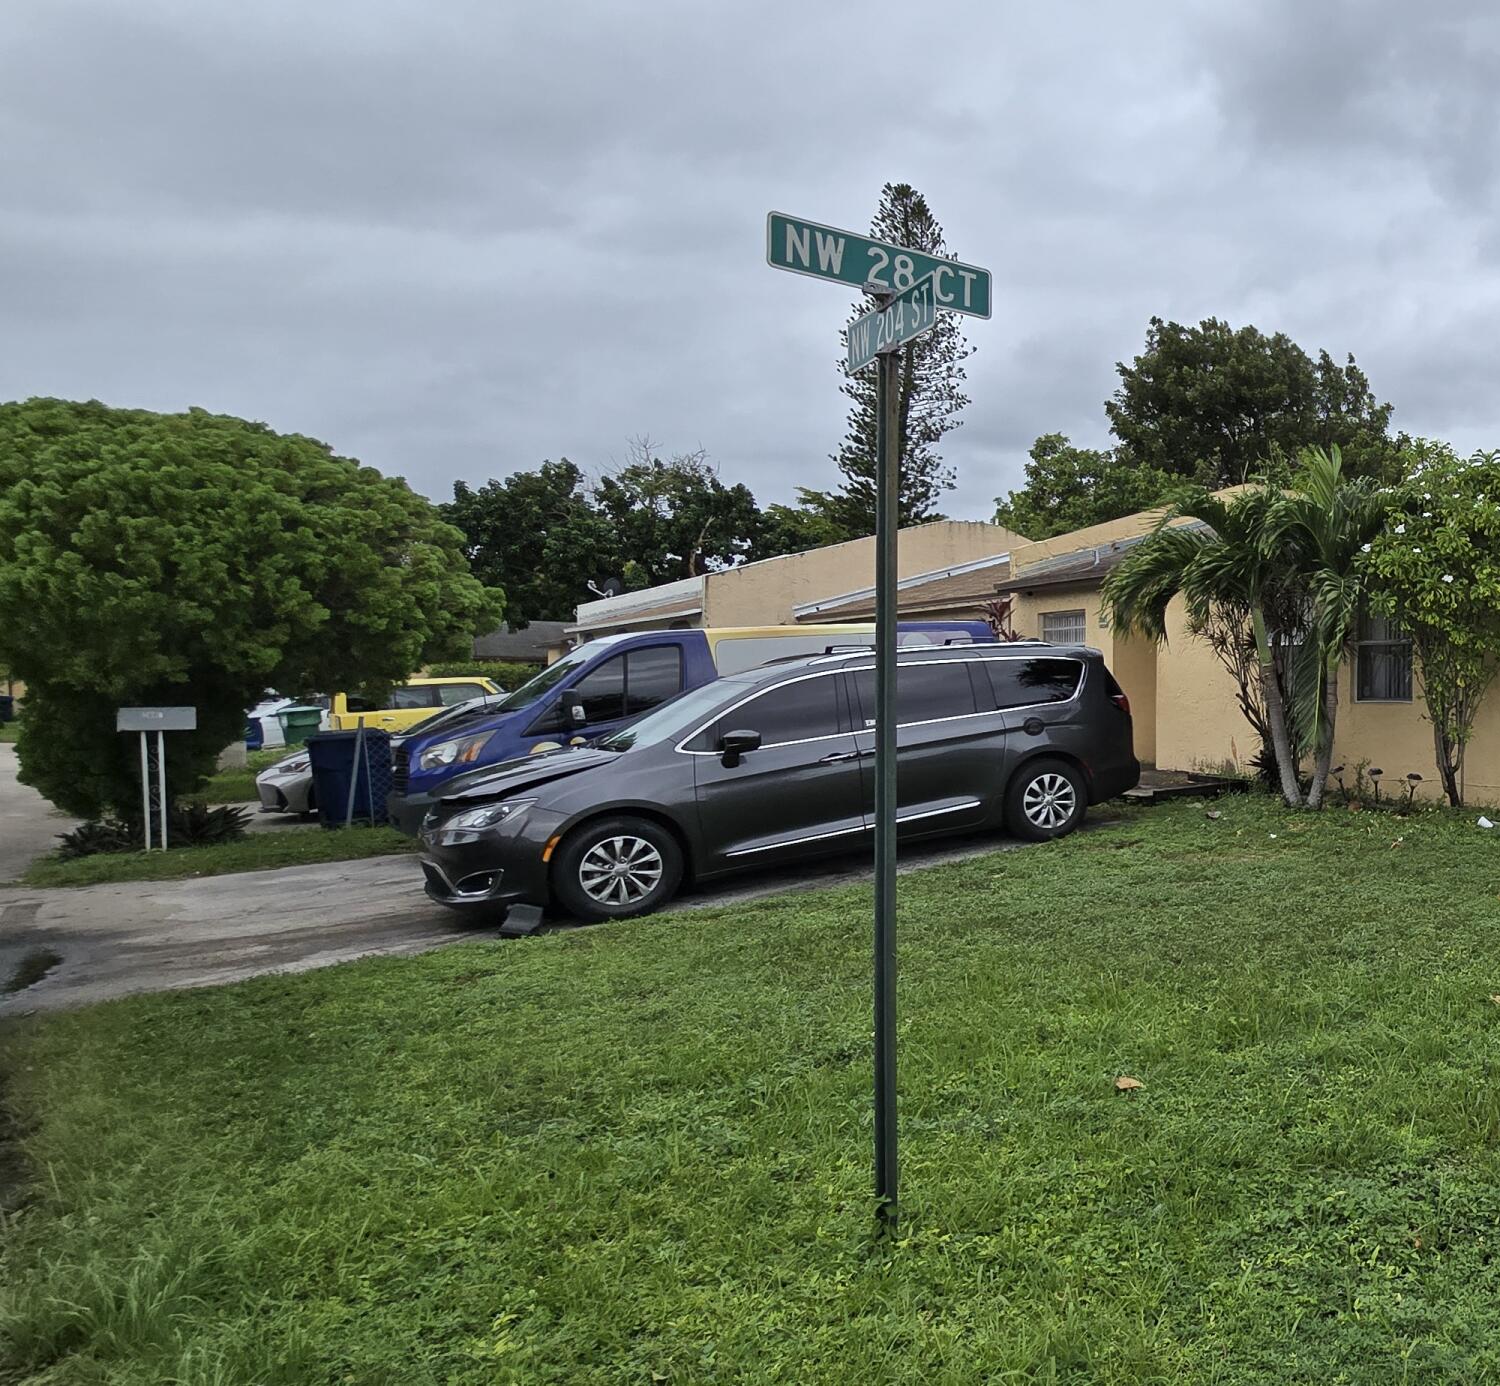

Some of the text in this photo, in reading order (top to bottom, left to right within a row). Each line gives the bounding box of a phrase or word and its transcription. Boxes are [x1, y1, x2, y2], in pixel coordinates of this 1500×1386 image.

[786, 224, 977, 308] NW 28 CT
[852, 283, 929, 365] NW 204 ST
